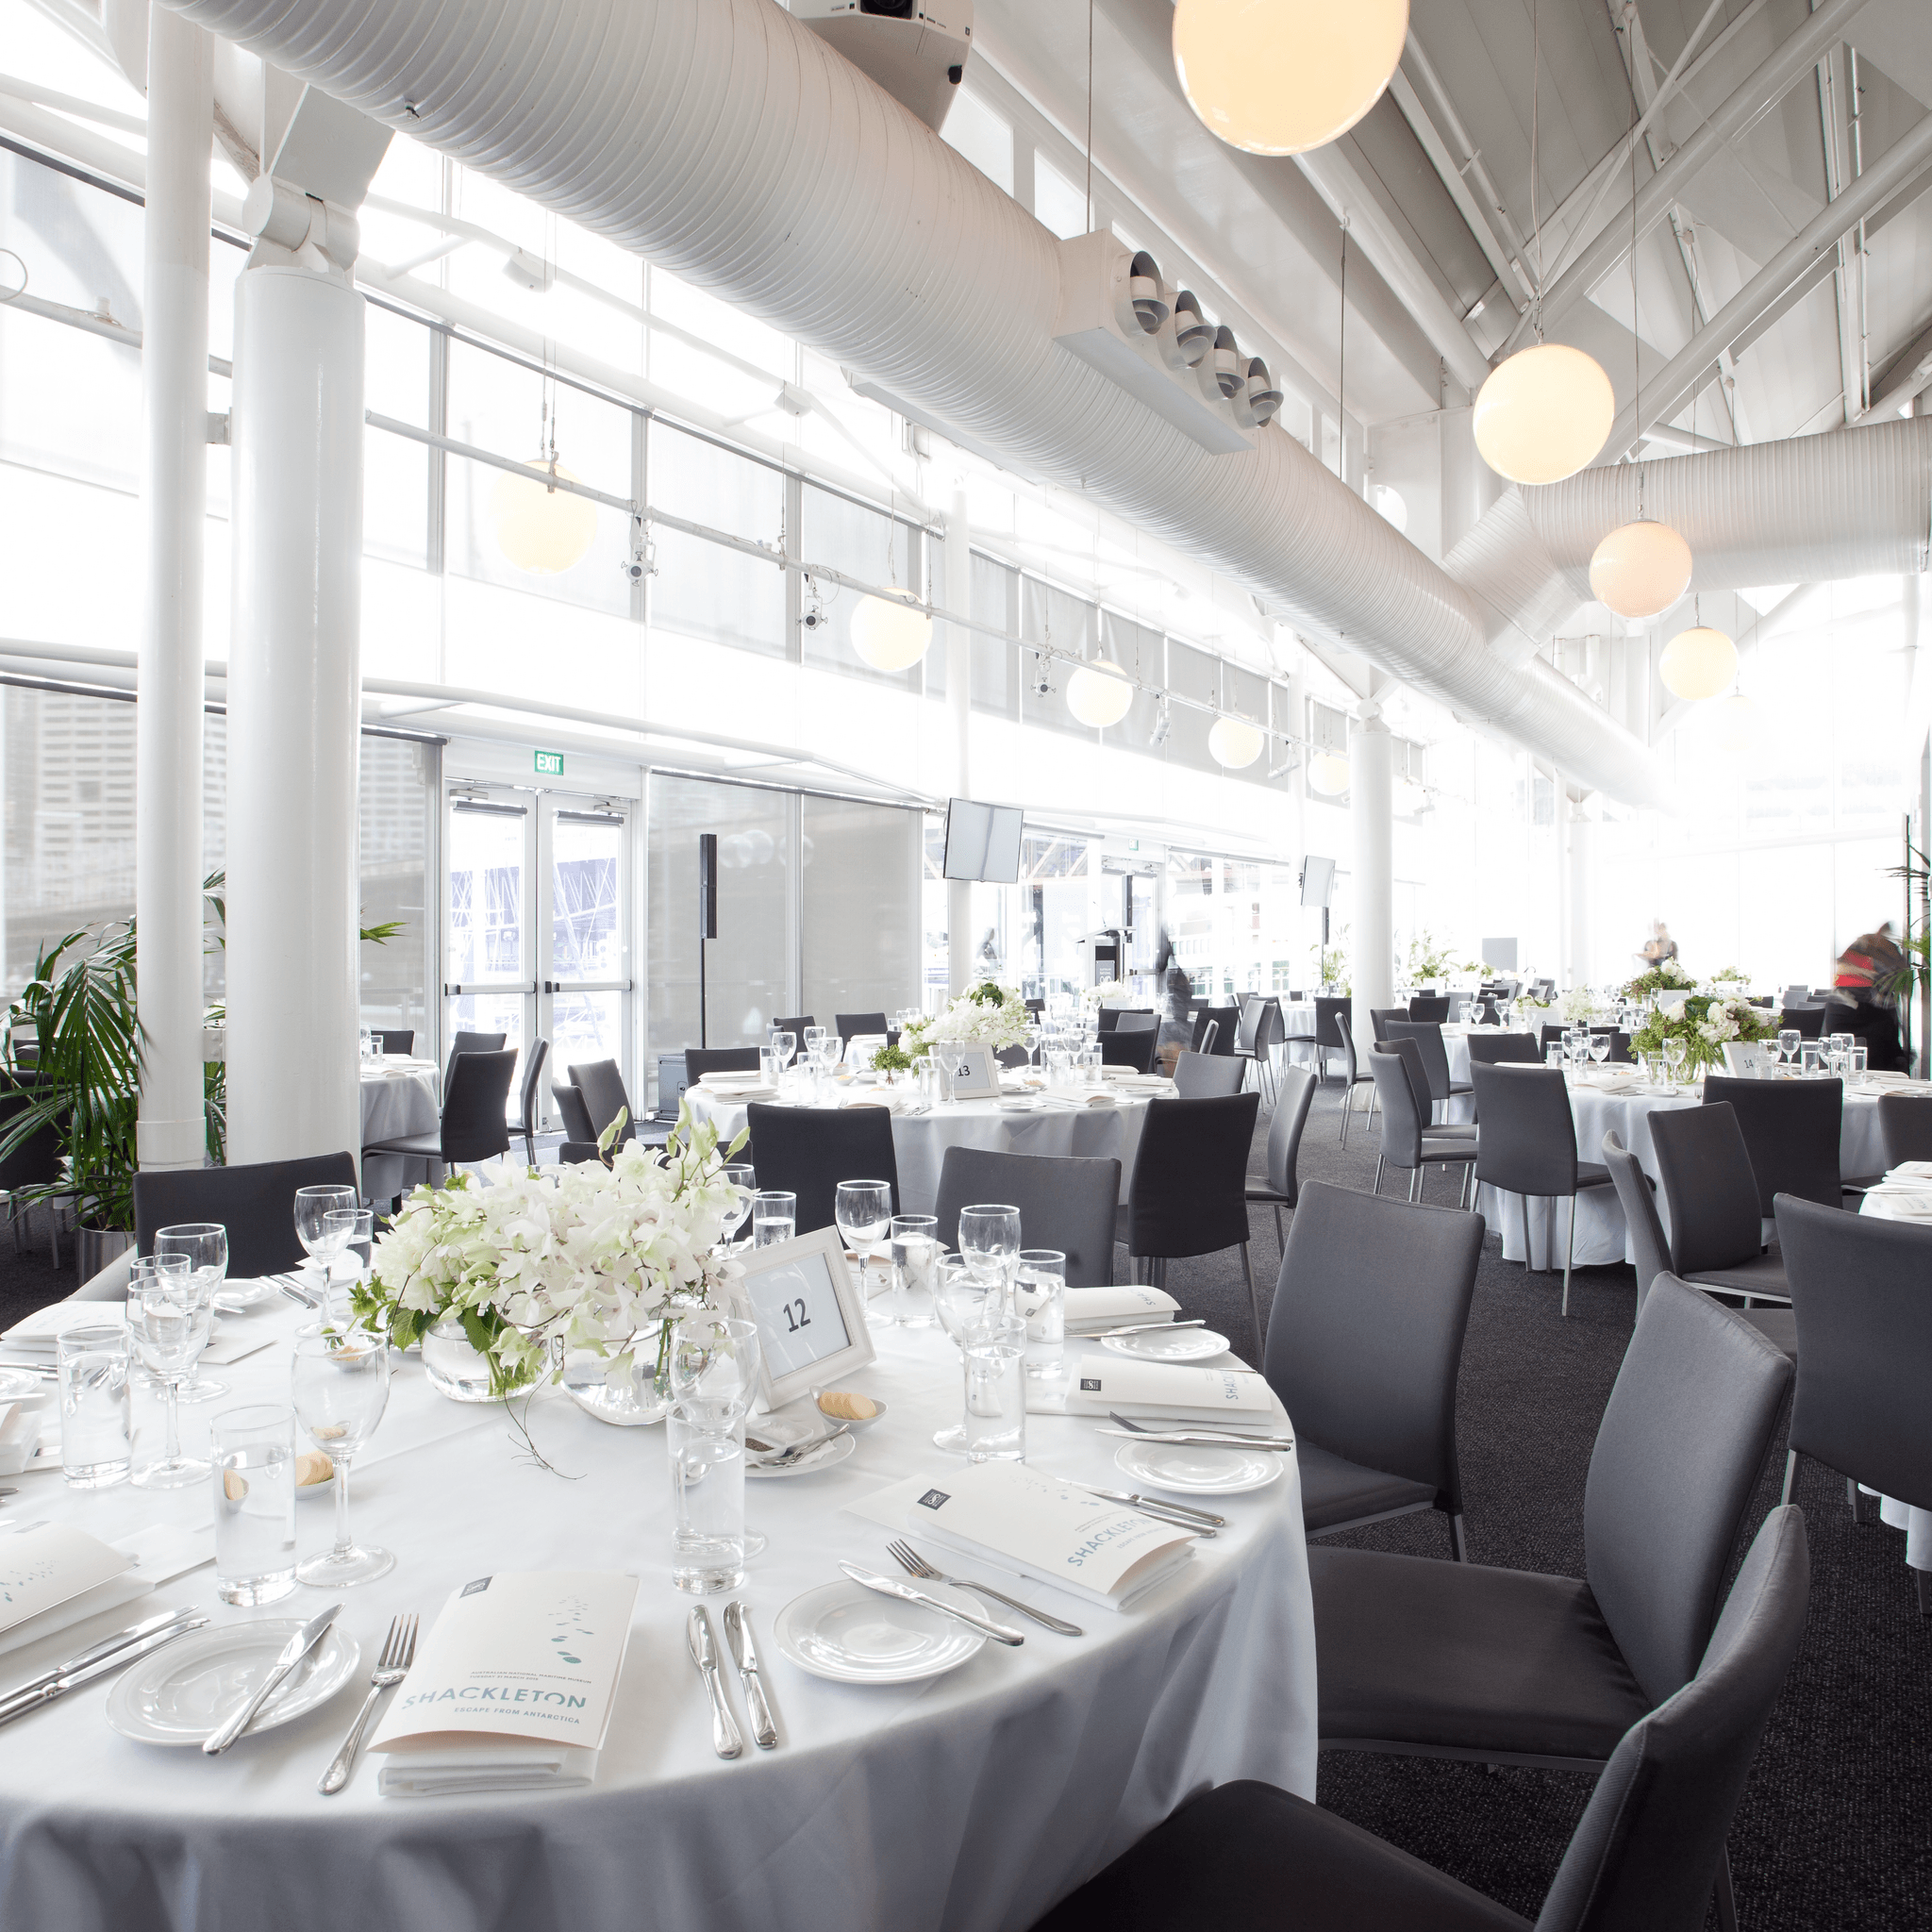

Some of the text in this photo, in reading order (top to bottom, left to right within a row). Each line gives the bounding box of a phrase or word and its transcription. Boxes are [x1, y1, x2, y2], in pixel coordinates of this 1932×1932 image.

[537, 754, 561, 772] EXIT
[958, 1065, 971, 1076] 13
[1744, 1059, 1754, 1068] 14
[783, 1298, 811, 1332] 12
[1068, 1517, 1152, 1567] SHACKLETON
[402, 1687, 586, 1709] SHACKLETON
[524, 1710, 580, 1724] ANTARCTICA
